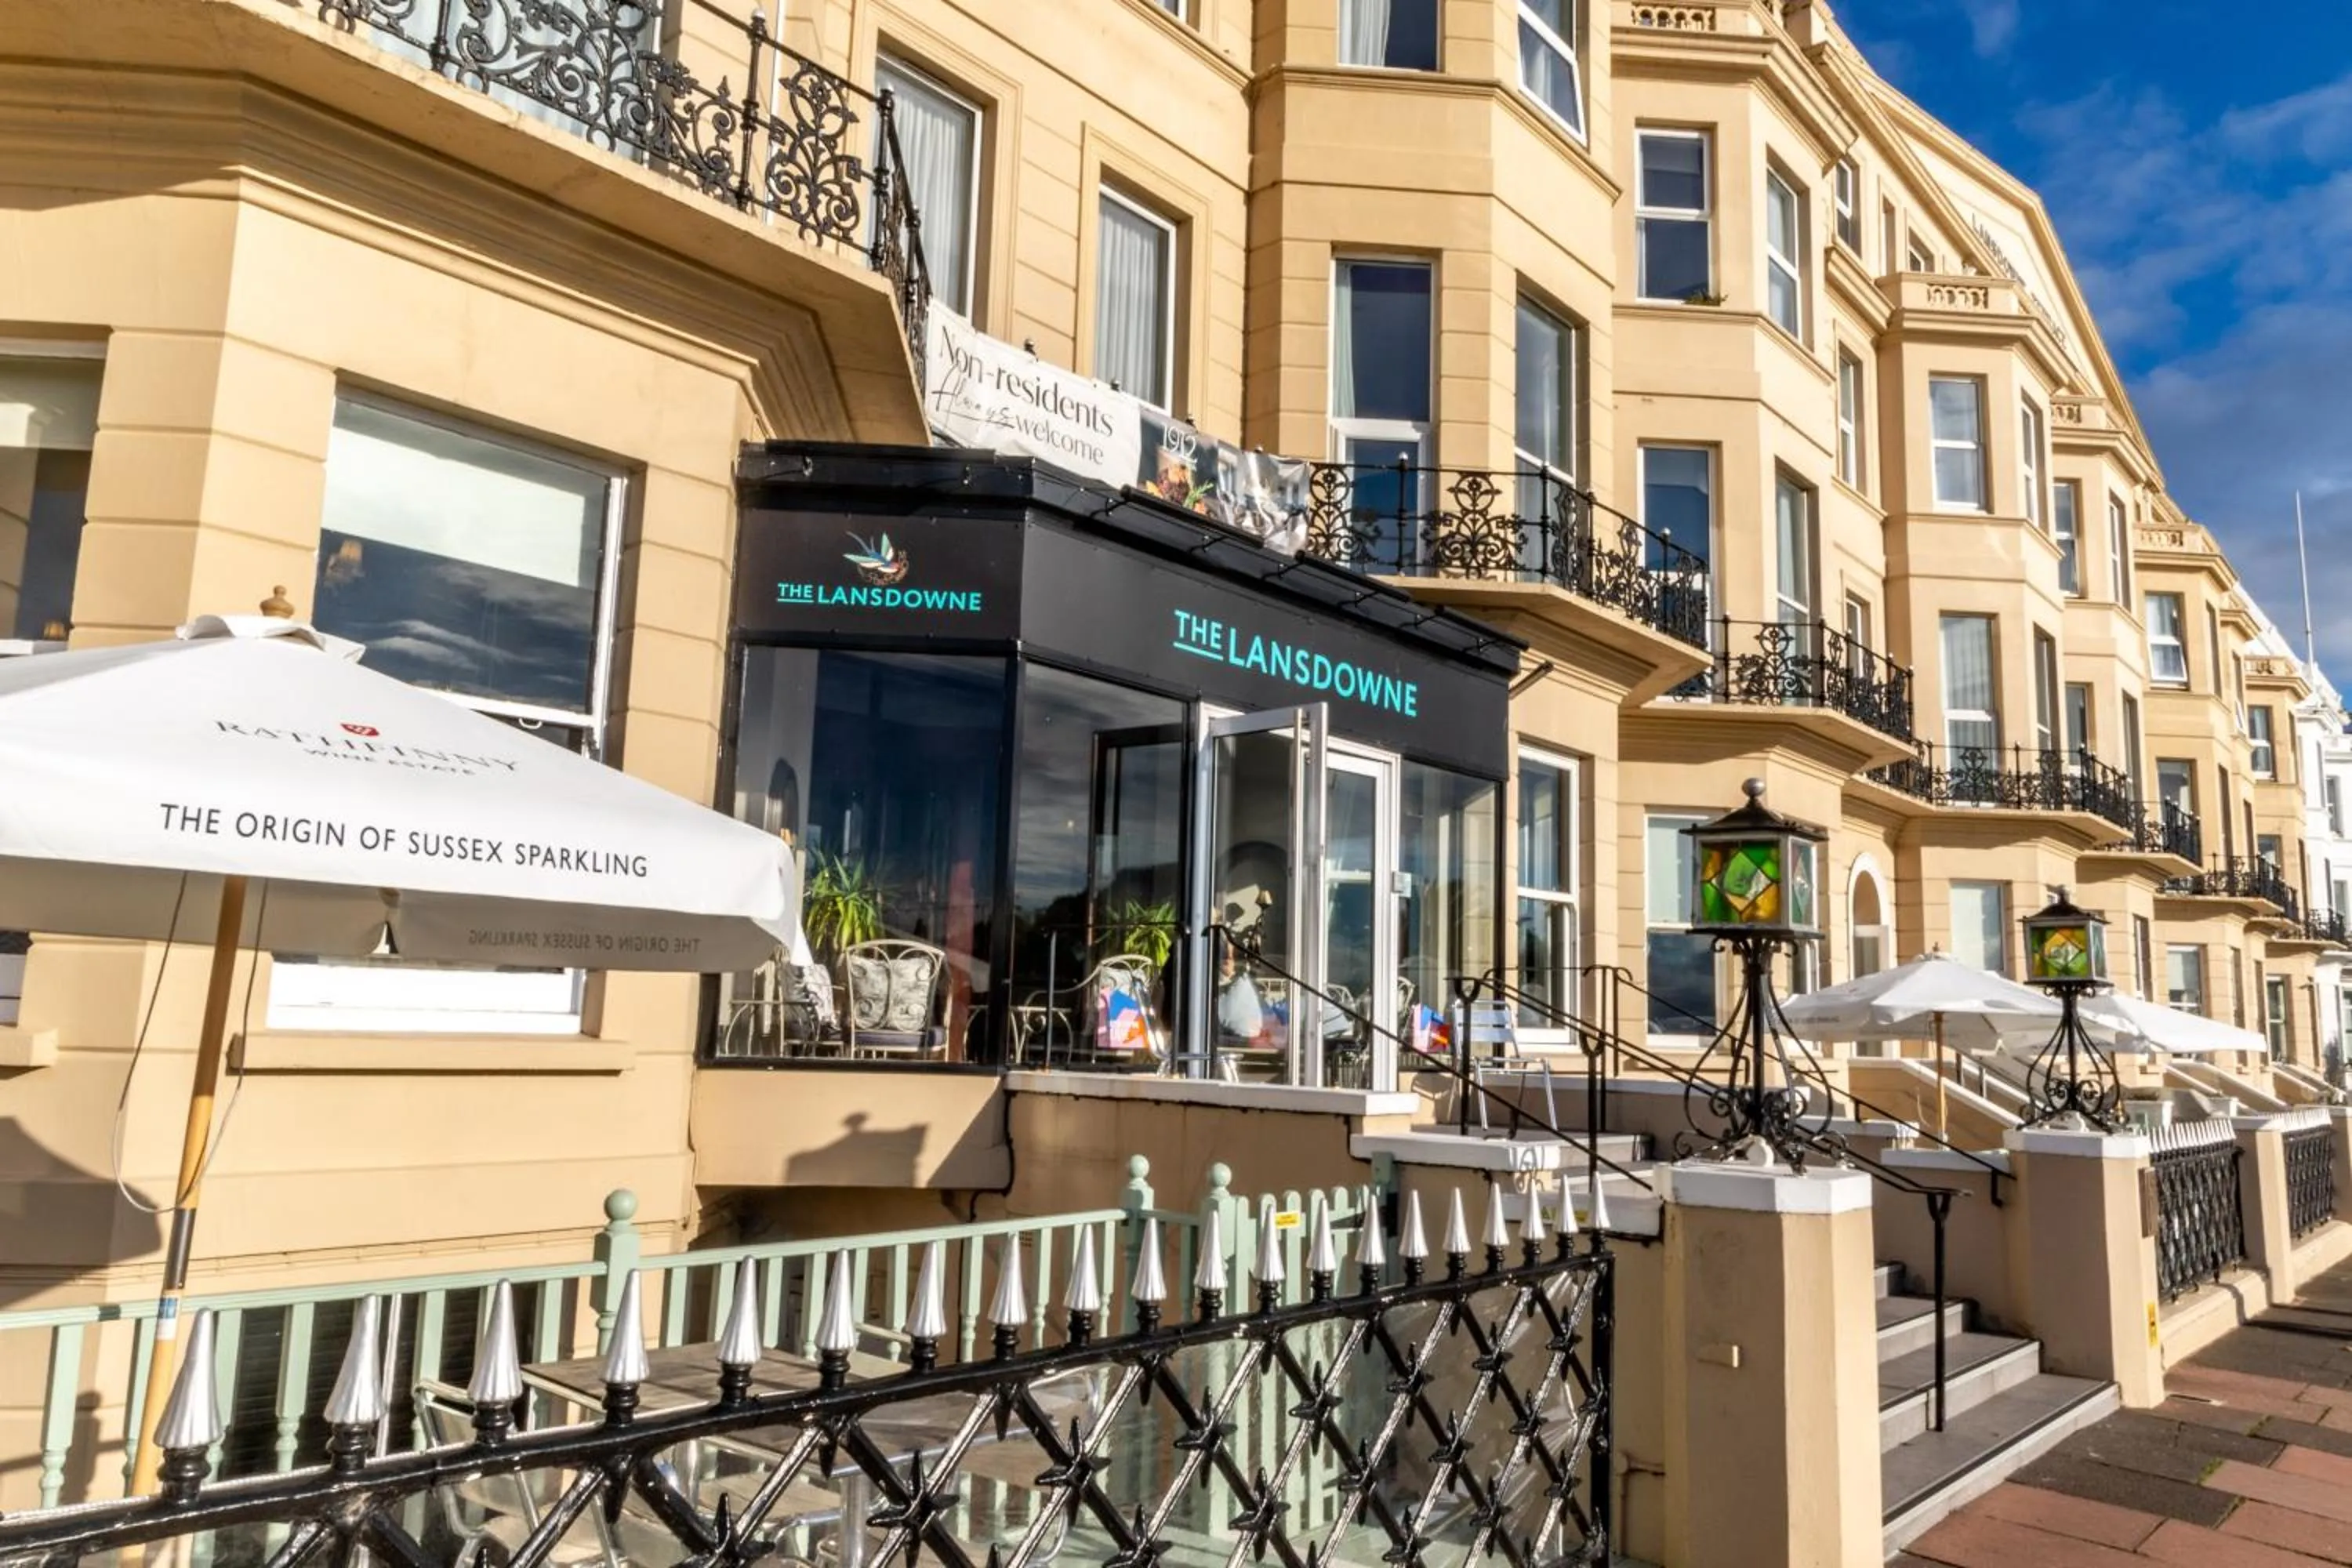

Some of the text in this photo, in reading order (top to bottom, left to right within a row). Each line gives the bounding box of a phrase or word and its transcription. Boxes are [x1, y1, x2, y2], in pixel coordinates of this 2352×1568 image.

[940, 325, 1114, 437] Non-residents
[1015, 414, 1105, 465] welcome
[778, 583, 982, 613] THE LANSDOWNE
[1174, 610, 1418, 717] THE LANSDOWNE
[161, 803, 648, 878] THE ORIGIN OF SUSSEX SPARKLING
